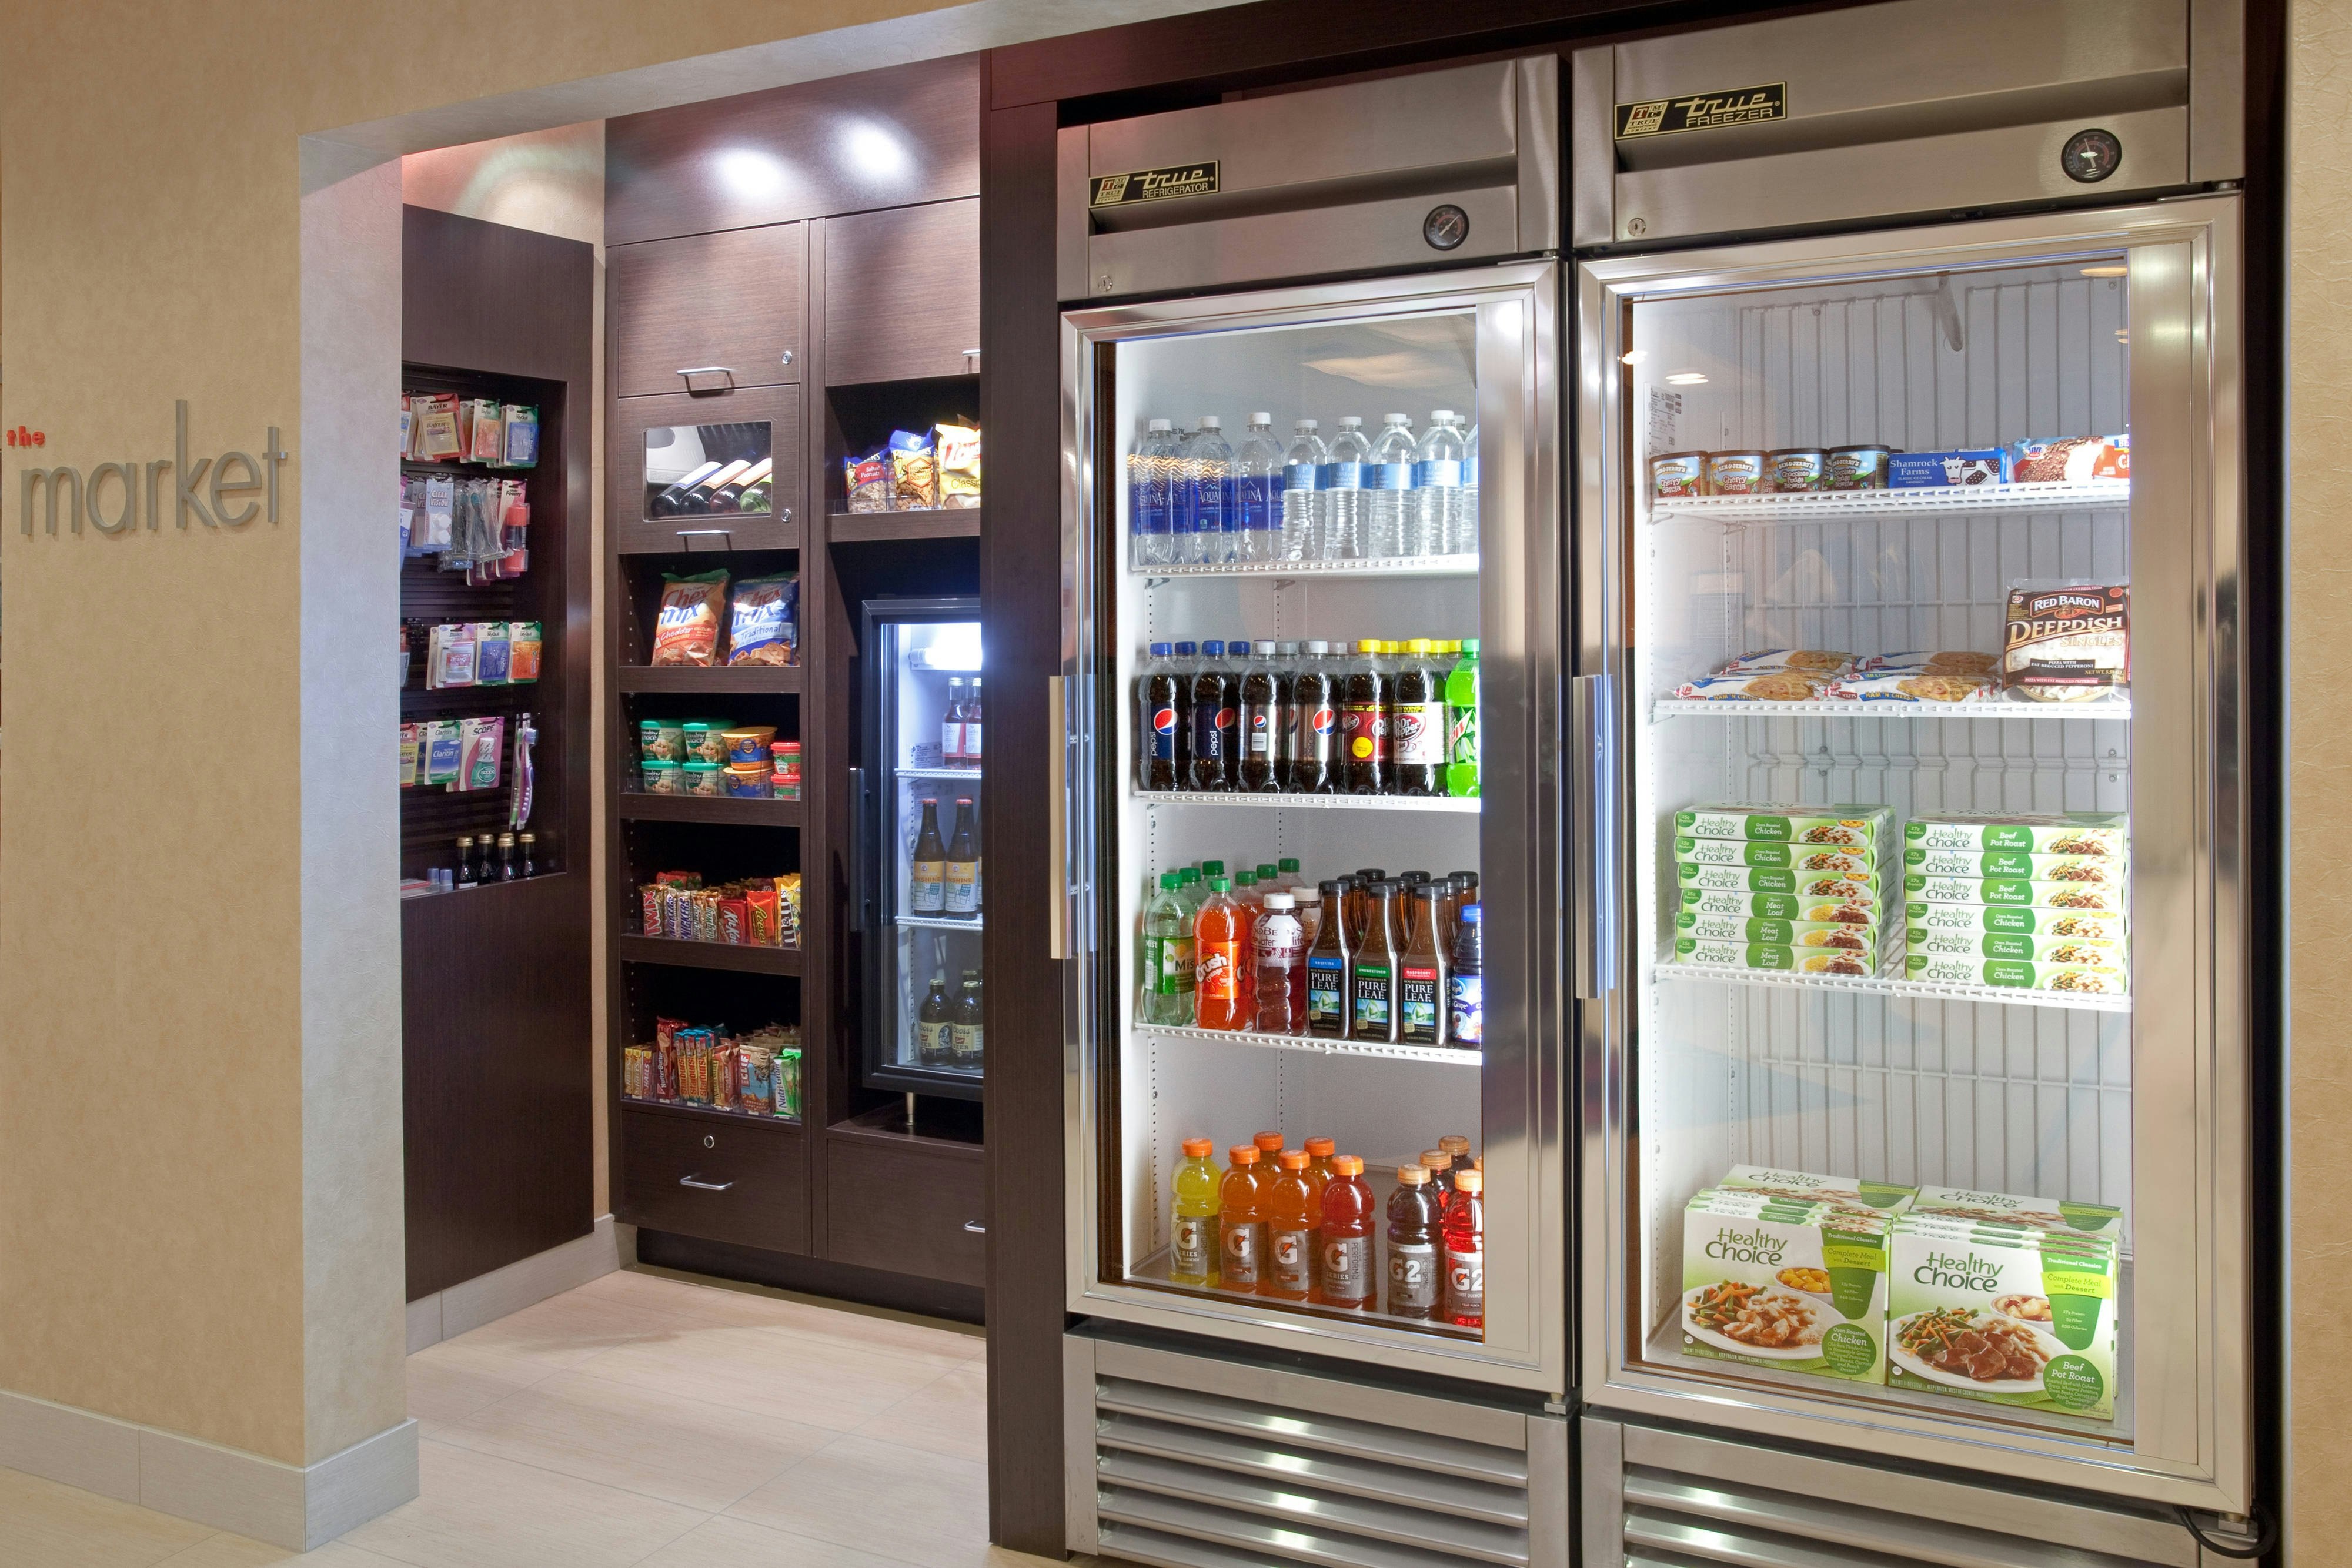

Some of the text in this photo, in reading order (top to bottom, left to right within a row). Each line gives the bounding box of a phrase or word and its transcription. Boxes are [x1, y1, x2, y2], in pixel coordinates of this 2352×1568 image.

[1686, 108, 1773, 127] FREEZER
[1143, 183, 1208, 198] REFRIGERATOR
[6, 426, 45, 446] the
[21, 399, 288, 534] market
[1890, 459, 1937, 467] Shamrock
[1900, 467, 1930, 476] Farms
[1660, 478, 1681, 487] Cherry
[1723, 475, 1747, 484] Cherry
[432, 490, 447, 499] CLEAR
[664, 589, 711, 607] Chex
[2034, 596, 2099, 611] RED BARON
[661, 604, 699, 625] mix
[740, 626, 781, 640] Traditional
[2060, 636, 2122, 646] SINGLES
[473, 725, 495, 735] SCOPE
[1149, 731, 1157, 756] pepsi
[1210, 730, 1218, 756] pepsi
[1701, 817, 1737, 828] Healthy
[1695, 825, 1735, 836] Choice
[1755, 827, 1782, 835] Chicken
[1933, 828, 1973, 839] Healthy
[1926, 836, 1970, 848] Choice
[1990, 839, 2026, 847] Pot Roast
[1700, 843, 1736, 855] Healthy
[1695, 851, 1733, 862] Choice
[1754, 854, 1782, 862] Chicken
[1932, 854, 1972, 865] Healthy
[1926, 863, 1969, 874] Choice
[2004, 865, 2024, 874] Roast
[1705, 869, 1740, 881] Healthy
[1699, 877, 1738, 888] Choice
[1758, 880, 1786, 888] Chicken
[1932, 881, 1972, 892] Healthy
[1707, 894, 1743, 905] Healthy
[1926, 889, 1969, 900] Choice
[2004, 892, 2025, 900] Roast
[644, 890, 662, 937] TWIX
[1701, 902, 1740, 914] Choice
[1934, 908, 1974, 920] Healthy
[1702, 918, 1738, 930] Healthy
[1927, 917, 1972, 928] Choice
[1994, 919, 2024, 927] Chicken
[1696, 927, 1735, 938] Choice
[1933, 934, 1973, 946] Healthy
[1702, 944, 1738, 956] Healthy
[1926, 942, 1970, 954] Choice
[1993, 945, 2023, 954] Chicken
[1696, 952, 1735, 964] Choice
[1175, 960, 1194, 971] Mis
[1934, 960, 1974, 972] Healthy
[1311, 972, 1338, 982] PURE
[1927, 969, 1971, 980] Choice
[1994, 972, 2024, 980] Chicken
[1359, 981, 1387, 991] PURE
[1405, 984, 1433, 993] PURE
[1748, 1174, 1820, 1188] Choice
[1764, 1171, 1827, 1184] Healthy
[1940, 1193, 2017, 1209] Choice
[1952, 1191, 2024, 1206] Healthy
[1176, 1222, 1197, 1249] G
[1716, 1227, 1788, 1252] Healthy
[1227, 1228, 1250, 1257] G
[1275, 1236, 1297, 1265] G
[1705, 1241, 1783, 1266] Choice
[1828, 1248, 1877, 1261] Complete Meal
[1325, 1243, 1348, 1272] G
[1843, 1258, 1870, 1267] Dessert
[2047, 1258, 2078, 1266] Traditional
[1389, 1257, 1421, 1282] G2
[1926, 1252, 2004, 1278] Healthy
[1913, 1266, 1999, 1293] Choice
[2047, 1273, 2102, 1288] Complete Meal
[2065, 1284, 2095, 1294] Dessert
[1831, 1333, 1867, 1346] Chicken
[2063, 1362, 2084, 1372] Beef
[2051, 1369, 2095, 1383] Pot Roast
